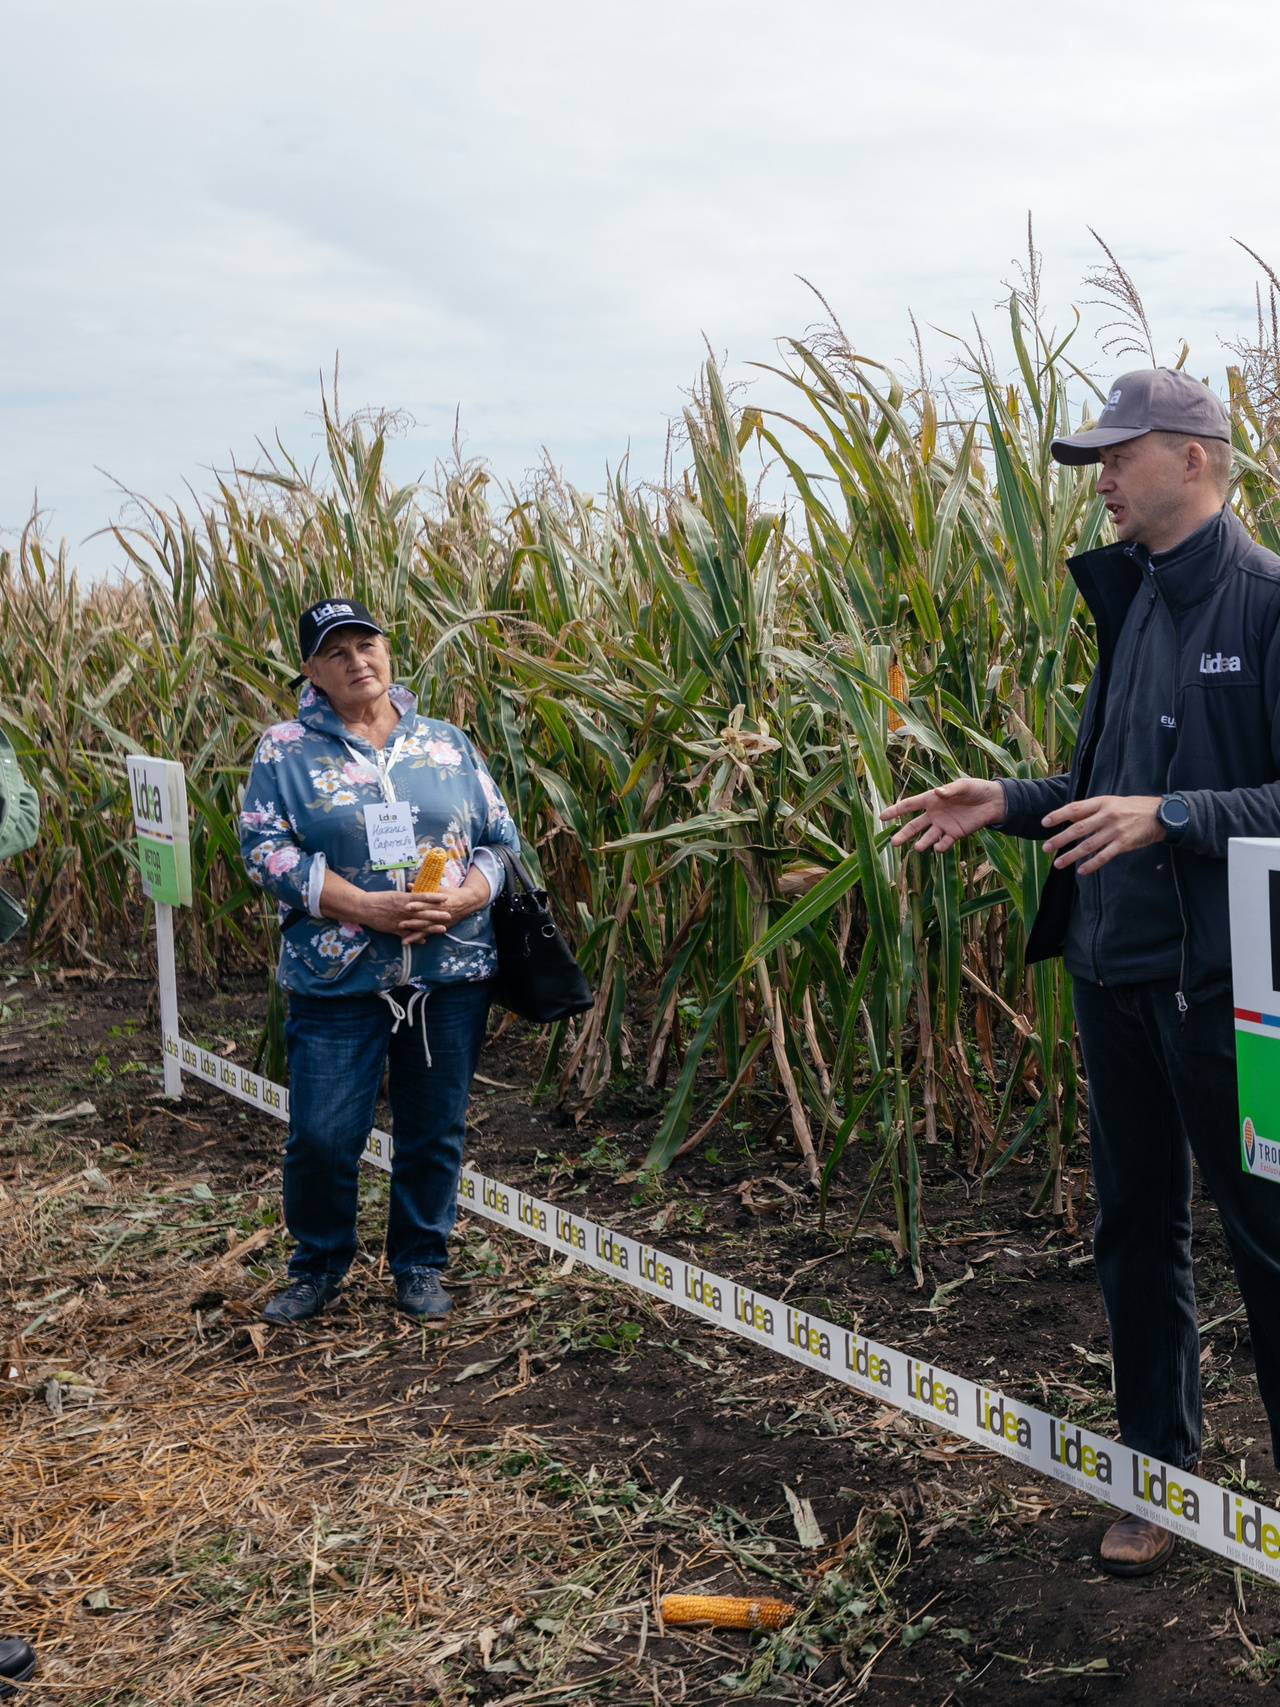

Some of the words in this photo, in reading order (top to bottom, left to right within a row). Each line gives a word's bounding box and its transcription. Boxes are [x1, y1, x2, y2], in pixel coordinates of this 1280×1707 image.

[311, 603, 353, 623] Lidea
[1200, 652, 1241, 673] Lidea
[1160, 715, 1176, 725] EU
[133, 768, 163, 825] Lidea
[164, 1032, 178, 1058] Lidea
[182, 1042, 197, 1068] Lidea
[200, 1051, 217, 1078] Lidea
[220, 1061, 236, 1088] Lidea
[240, 1070, 258, 1098] Lidea
[262, 1080, 280, 1109] Lidea
[482, 1177, 509, 1216] Lidea
[518, 1192, 547, 1233] Lidea
[555, 1209, 586, 1251] Lidea
[595, 1227, 629, 1271] Lidea
[638, 1246, 673, 1291] Lidea
[684, 1265, 722, 1313] Lidea
[734, 1286, 774, 1336] Lidea
[786, 1308, 831, 1361] Lidea
[844, 1333, 892, 1388] Lidea
[907, 1358, 959, 1418] Lidea
[975, 1387, 1032, 1450] Lidea
[1050, 1418, 1113, 1485] Lidea
[1132, 1453, 1200, 1525] Lidea
